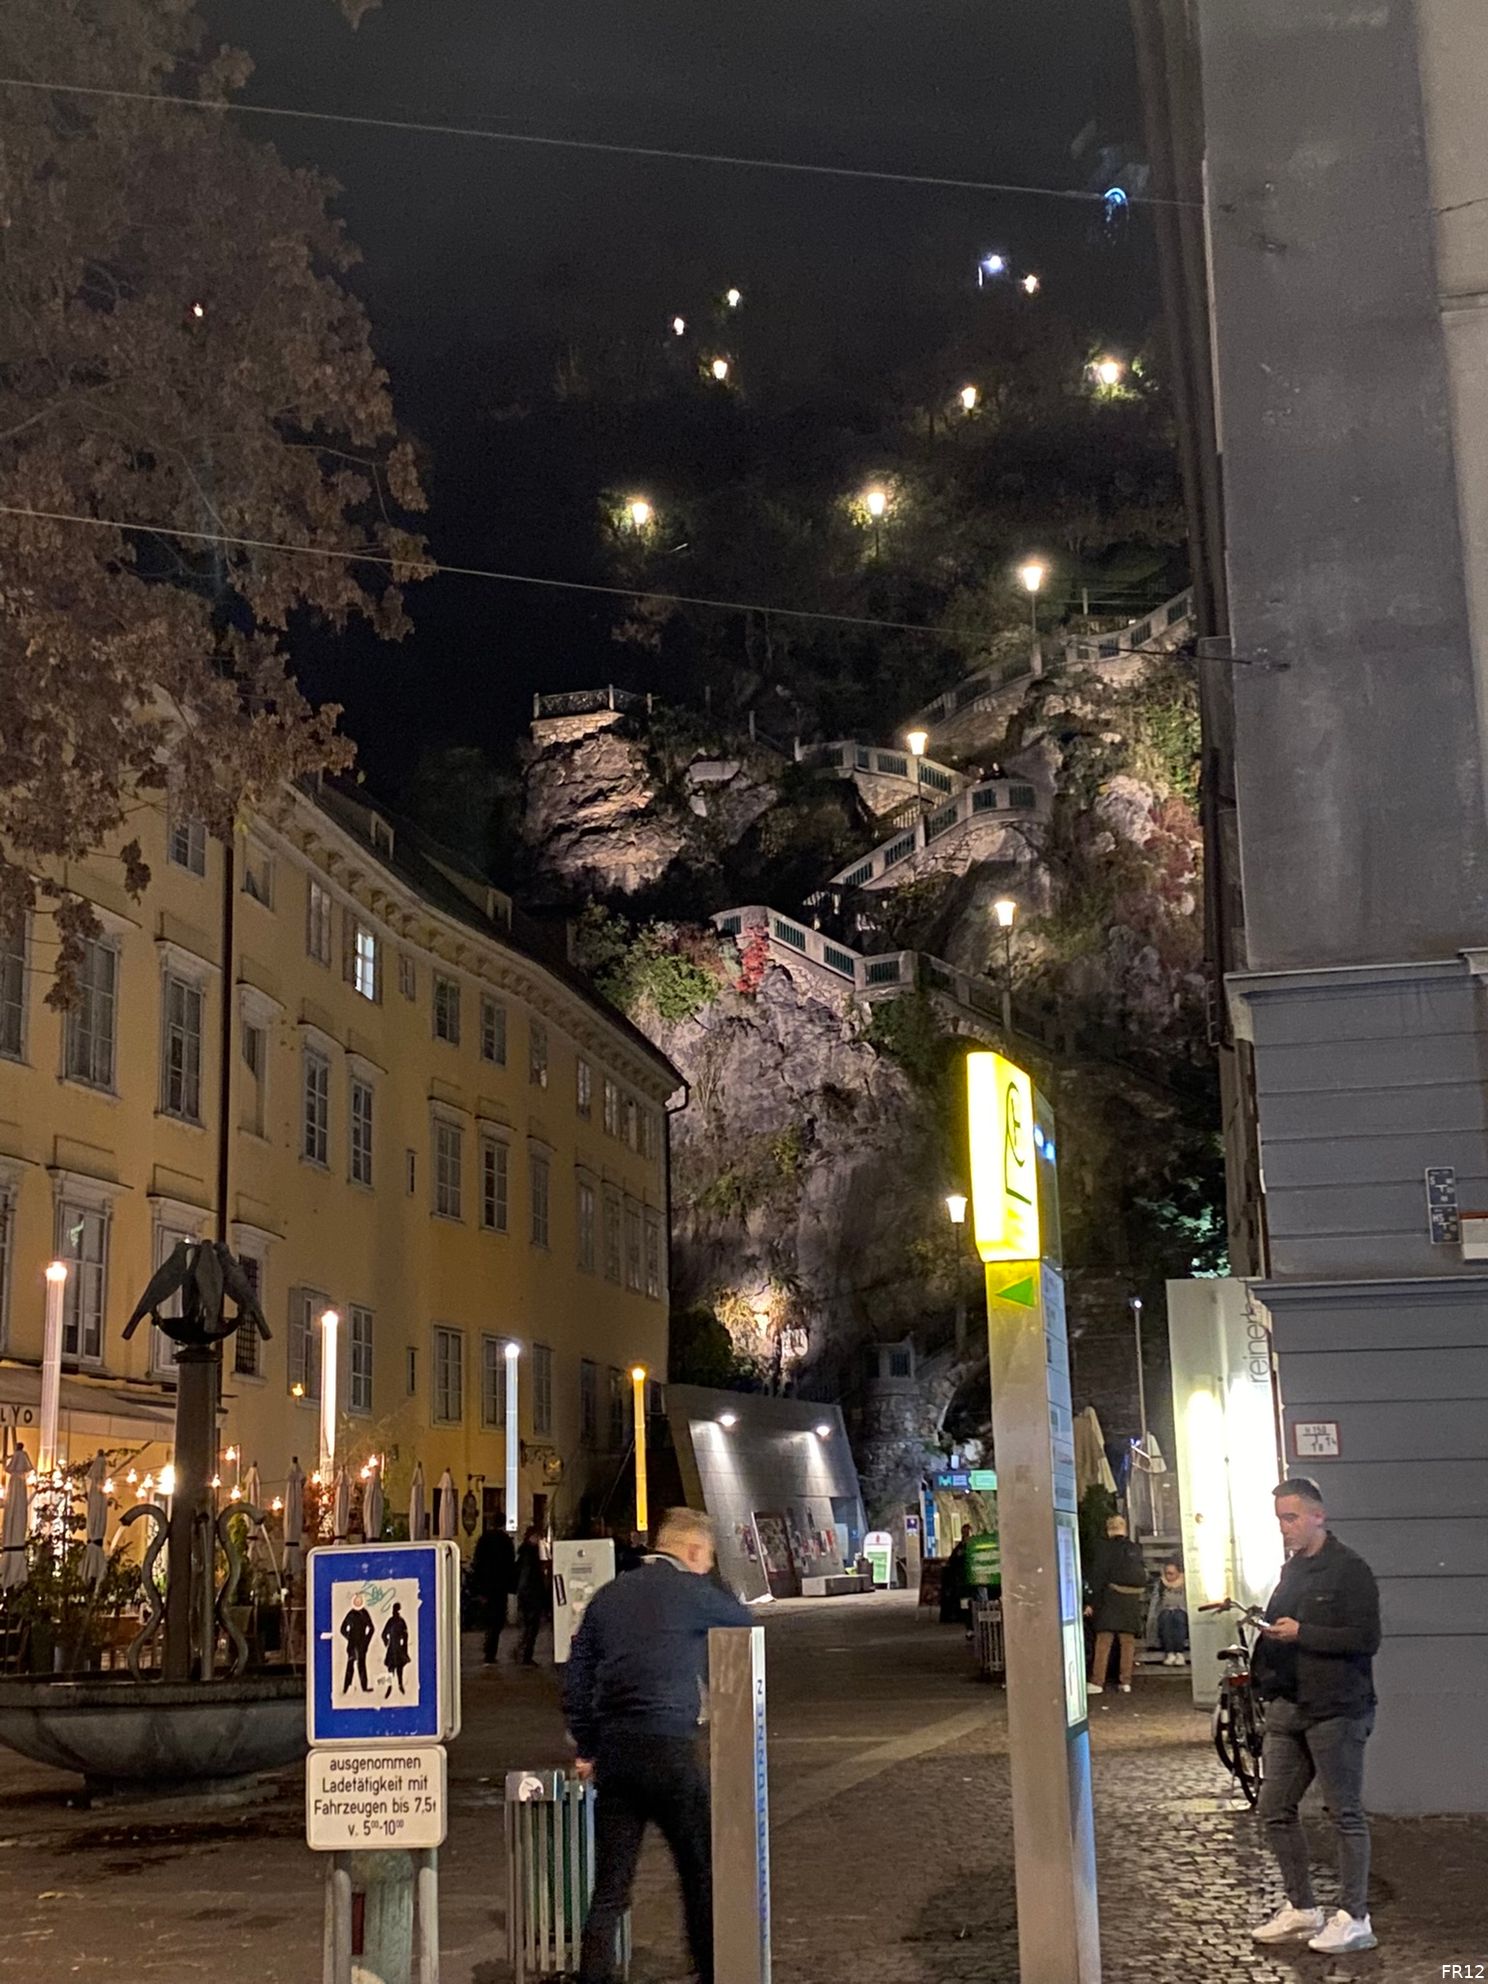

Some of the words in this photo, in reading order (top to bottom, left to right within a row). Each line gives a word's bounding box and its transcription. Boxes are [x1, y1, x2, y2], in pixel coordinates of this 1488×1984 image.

[329, 1757, 422, 1774] ausgenommen
[322, 1775, 403, 1796] Ladetätigkeit
[407, 1775, 428, 1791] mit
[314, 1798, 388, 1818] Fahrzeugen
[392, 1797, 410, 1814] bis
[347, 1824, 359, 1837] v.
